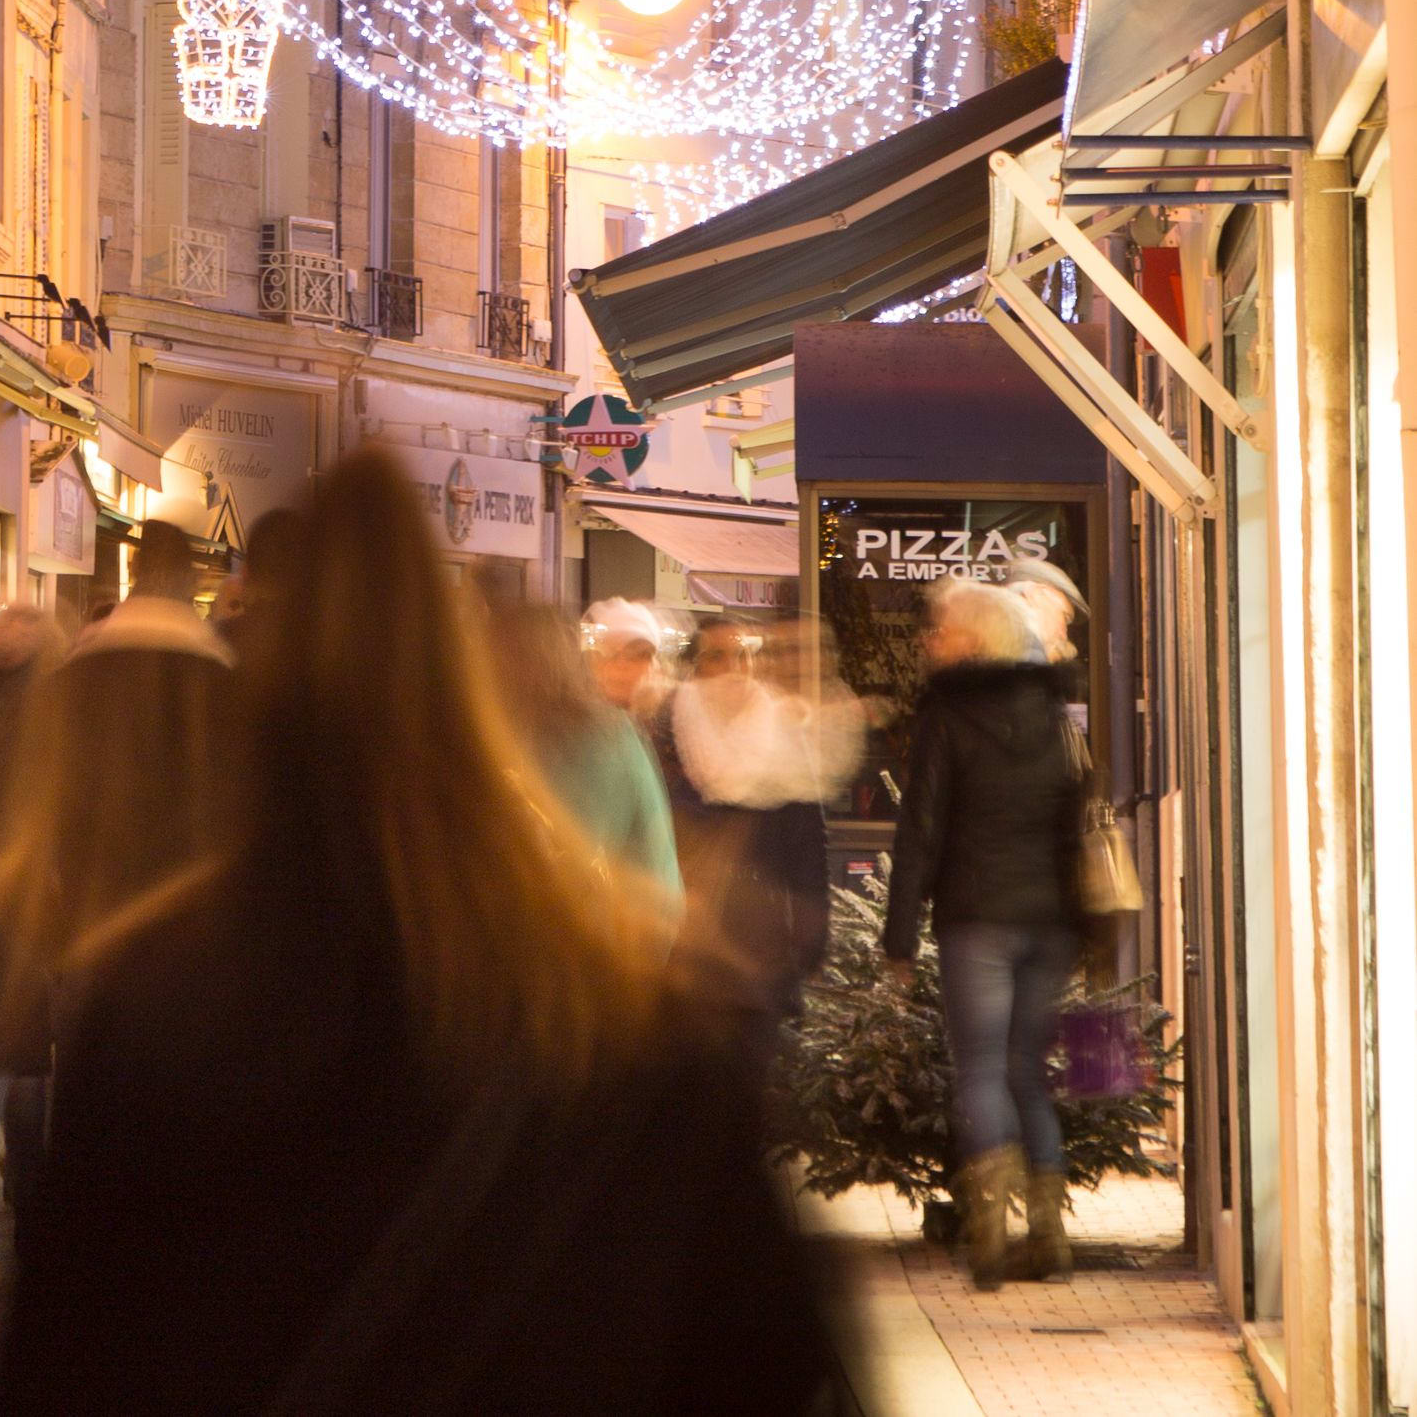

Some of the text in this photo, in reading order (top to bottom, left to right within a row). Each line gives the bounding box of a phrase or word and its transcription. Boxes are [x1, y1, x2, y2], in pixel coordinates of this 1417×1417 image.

[179, 404, 275, 438] Michel HUVELIN
[570, 433, 635, 445] TCHIP
[513, 493, 535, 526] PRIX
[856, 529, 1048, 561] PIZZAS
[857, 562, 879, 579] A
[735, 580, 752, 604] UN
